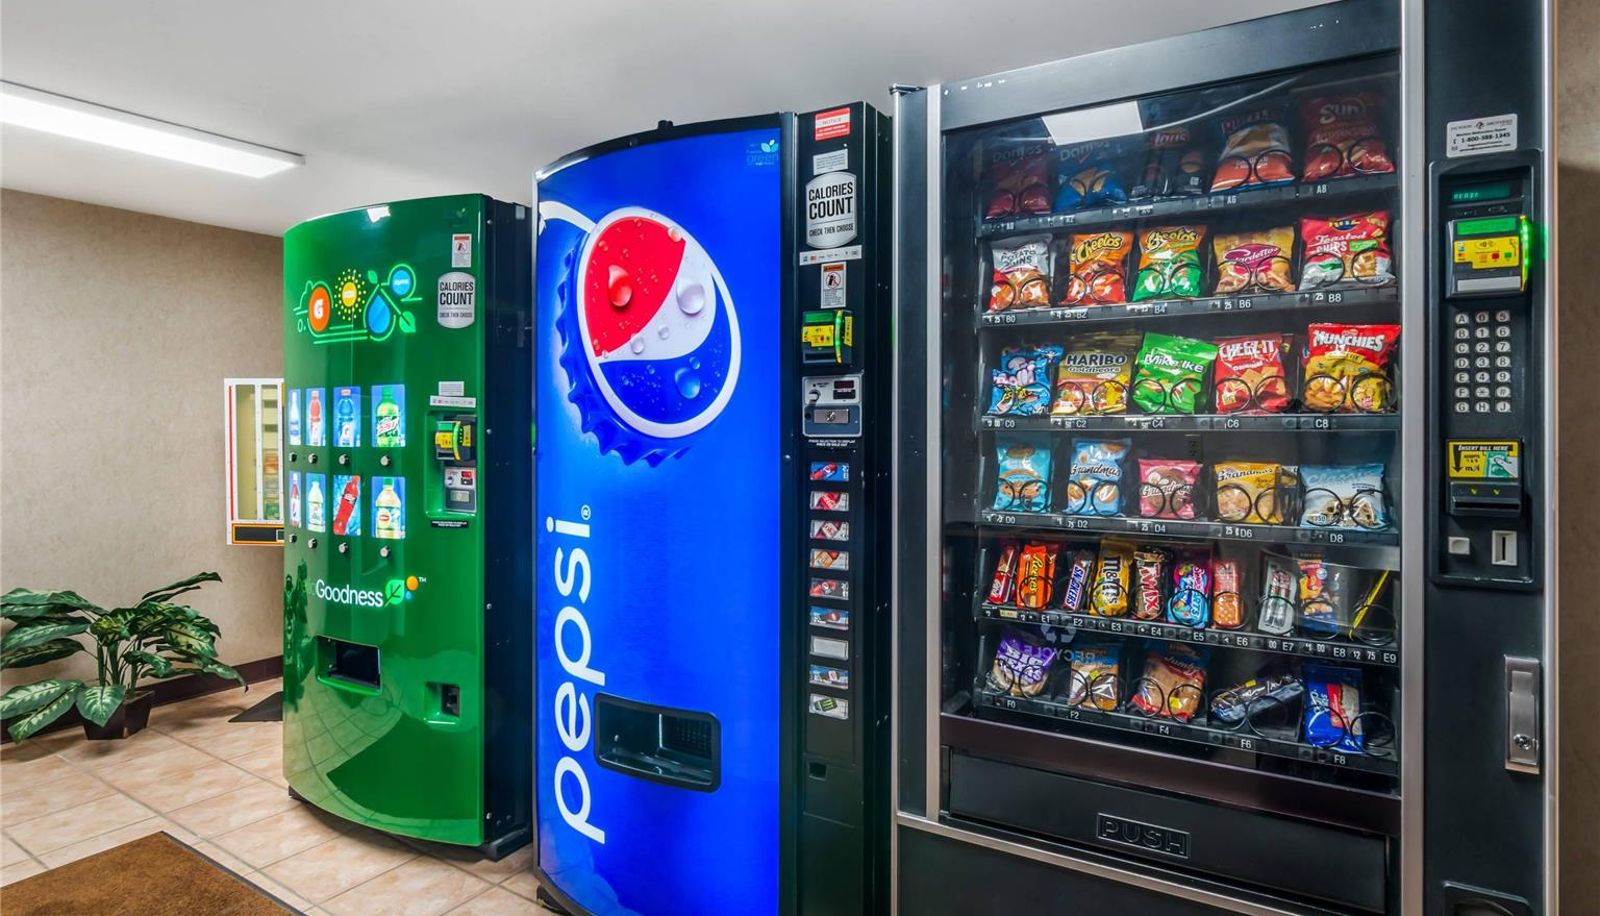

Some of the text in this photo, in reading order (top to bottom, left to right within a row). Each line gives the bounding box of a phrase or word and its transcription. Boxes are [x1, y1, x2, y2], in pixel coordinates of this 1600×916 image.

[808, 182, 853, 202] CALORIES
[1316, 185, 1327, 194] A8
[809, 196, 853, 220] COUNT
[825, 224, 836, 234] THEN
[1315, 231, 1367, 244] Toasted
[1075, 234, 1123, 262] Cheetos
[440, 282, 474, 292] CALORIES
[440, 292, 473, 306] COUNT
[1328, 294, 1342, 302] B8
[1239, 300, 1251, 308] B6
[1076, 310, 1087, 319] B2
[1154, 306, 1166, 314] B4
[1458, 315, 1465, 323] A
[1458, 330, 1466, 338] B
[1500, 328, 1506, 336] 6
[1313, 330, 1385, 351] MUNCHIES
[1458, 344, 1466, 352] C
[1479, 344, 1486, 352] 2
[1066, 354, 1127, 366] HARIBO
[1458, 359, 1466, 367] D
[1479, 358, 1486, 366] 3
[1500, 358, 1506, 366] 8
[1182, 360, 1204, 373] Ike
[1458, 374, 1465, 382] E
[1500, 372, 1506, 380] 9
[1458, 404, 1466, 412] G
[1479, 403, 1486, 412] H
[1500, 403, 1506, 412] J
[1005, 419, 1016, 428] C0
[1076, 419, 1087, 428] C2
[1152, 419, 1164, 428] C4
[1227, 418, 1240, 428] C6
[1316, 418, 1329, 428] C8
[1005, 516, 1016, 524] D0
[1077, 520, 1088, 528] D2
[1154, 524, 1166, 532] D4
[1240, 530, 1252, 538] D6
[1330, 534, 1344, 543] D8
[1066, 566, 1084, 610] SNICKERS
[1139, 564, 1160, 612] TWIX
[316, 578, 384, 608] Goodness
[1041, 615, 1050, 623] E1
[1074, 618, 1083, 626] E2
[1111, 622, 1122, 632] E3
[1152, 627, 1162, 636] E4
[1194, 632, 1204, 641] E5
[1237, 637, 1248, 646] E6
[1282, 642, 1294, 651] E7
[1006, 642, 1043, 666] BIG
[1334, 647, 1346, 657] E8
[1367, 651, 1376, 660] 75
[1384, 653, 1396, 663] E9
[546, 516, 606, 844] pepsi
[1007, 700, 1016, 708] F0
[1070, 711, 1079, 720] F2
[1159, 726, 1170, 735] F4
[1240, 740, 1252, 748] F6
[1334, 754, 1346, 765] F8
[1102, 818, 1185, 854] PUSH
